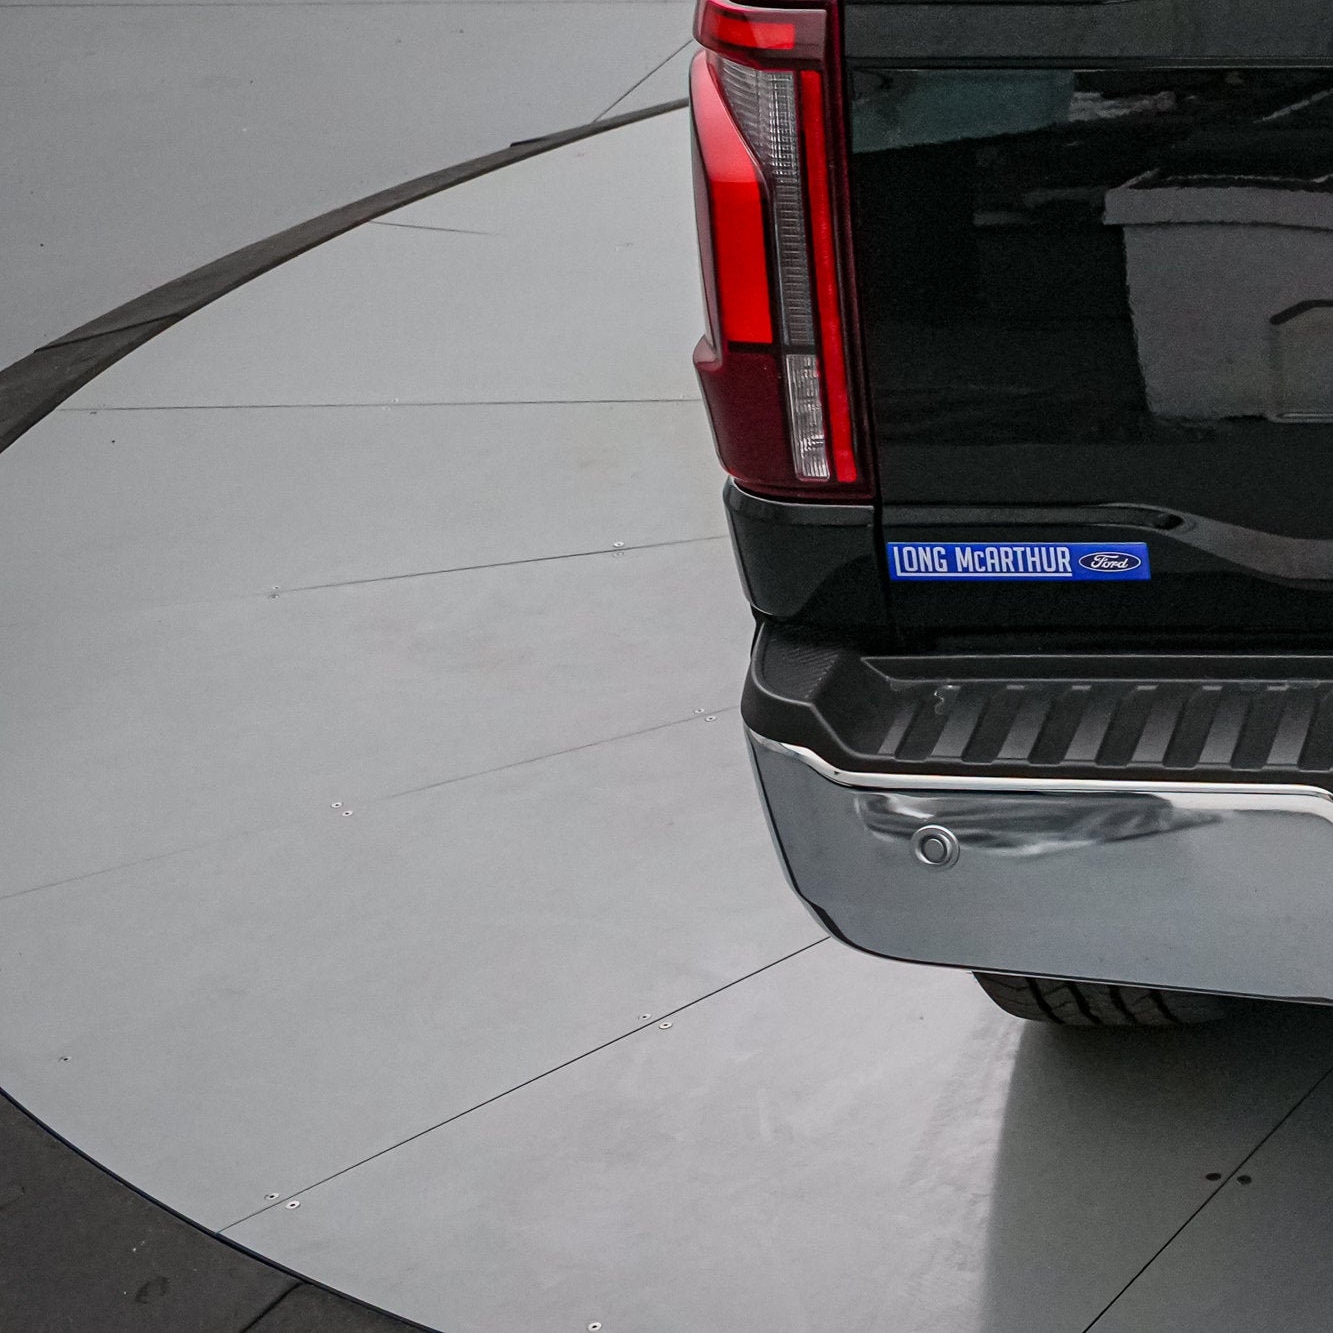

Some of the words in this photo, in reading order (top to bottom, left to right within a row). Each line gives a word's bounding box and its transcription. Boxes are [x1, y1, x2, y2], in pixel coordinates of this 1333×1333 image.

[893, 546, 947, 576] LONG
[955, 546, 1073, 573] McARTHUR
[1090, 553, 1129, 570] Ford
